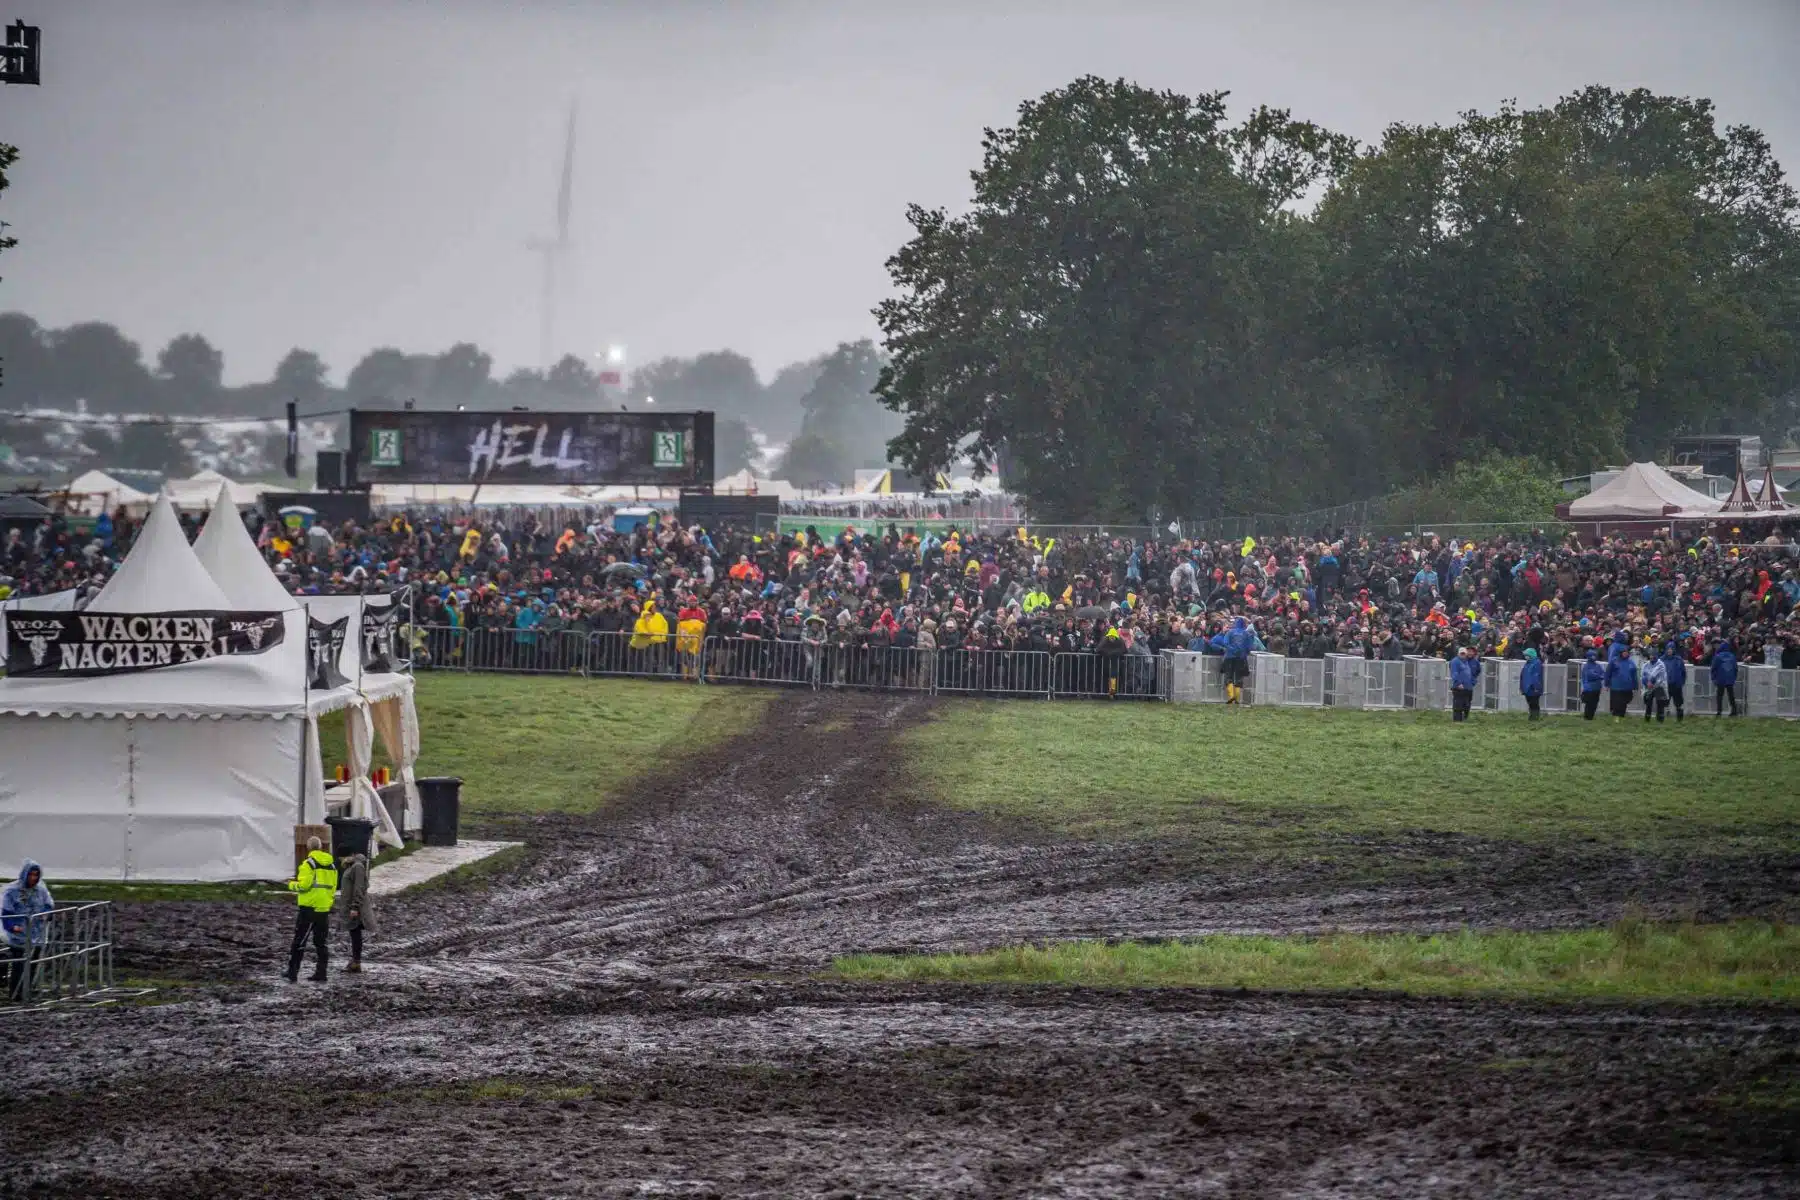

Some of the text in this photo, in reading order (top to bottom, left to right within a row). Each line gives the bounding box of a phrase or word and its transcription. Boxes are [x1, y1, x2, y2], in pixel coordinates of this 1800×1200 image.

[466, 419, 590, 481] HELL
[78, 616, 214, 641] WACKEN
[58, 642, 173, 670] NACKEN
